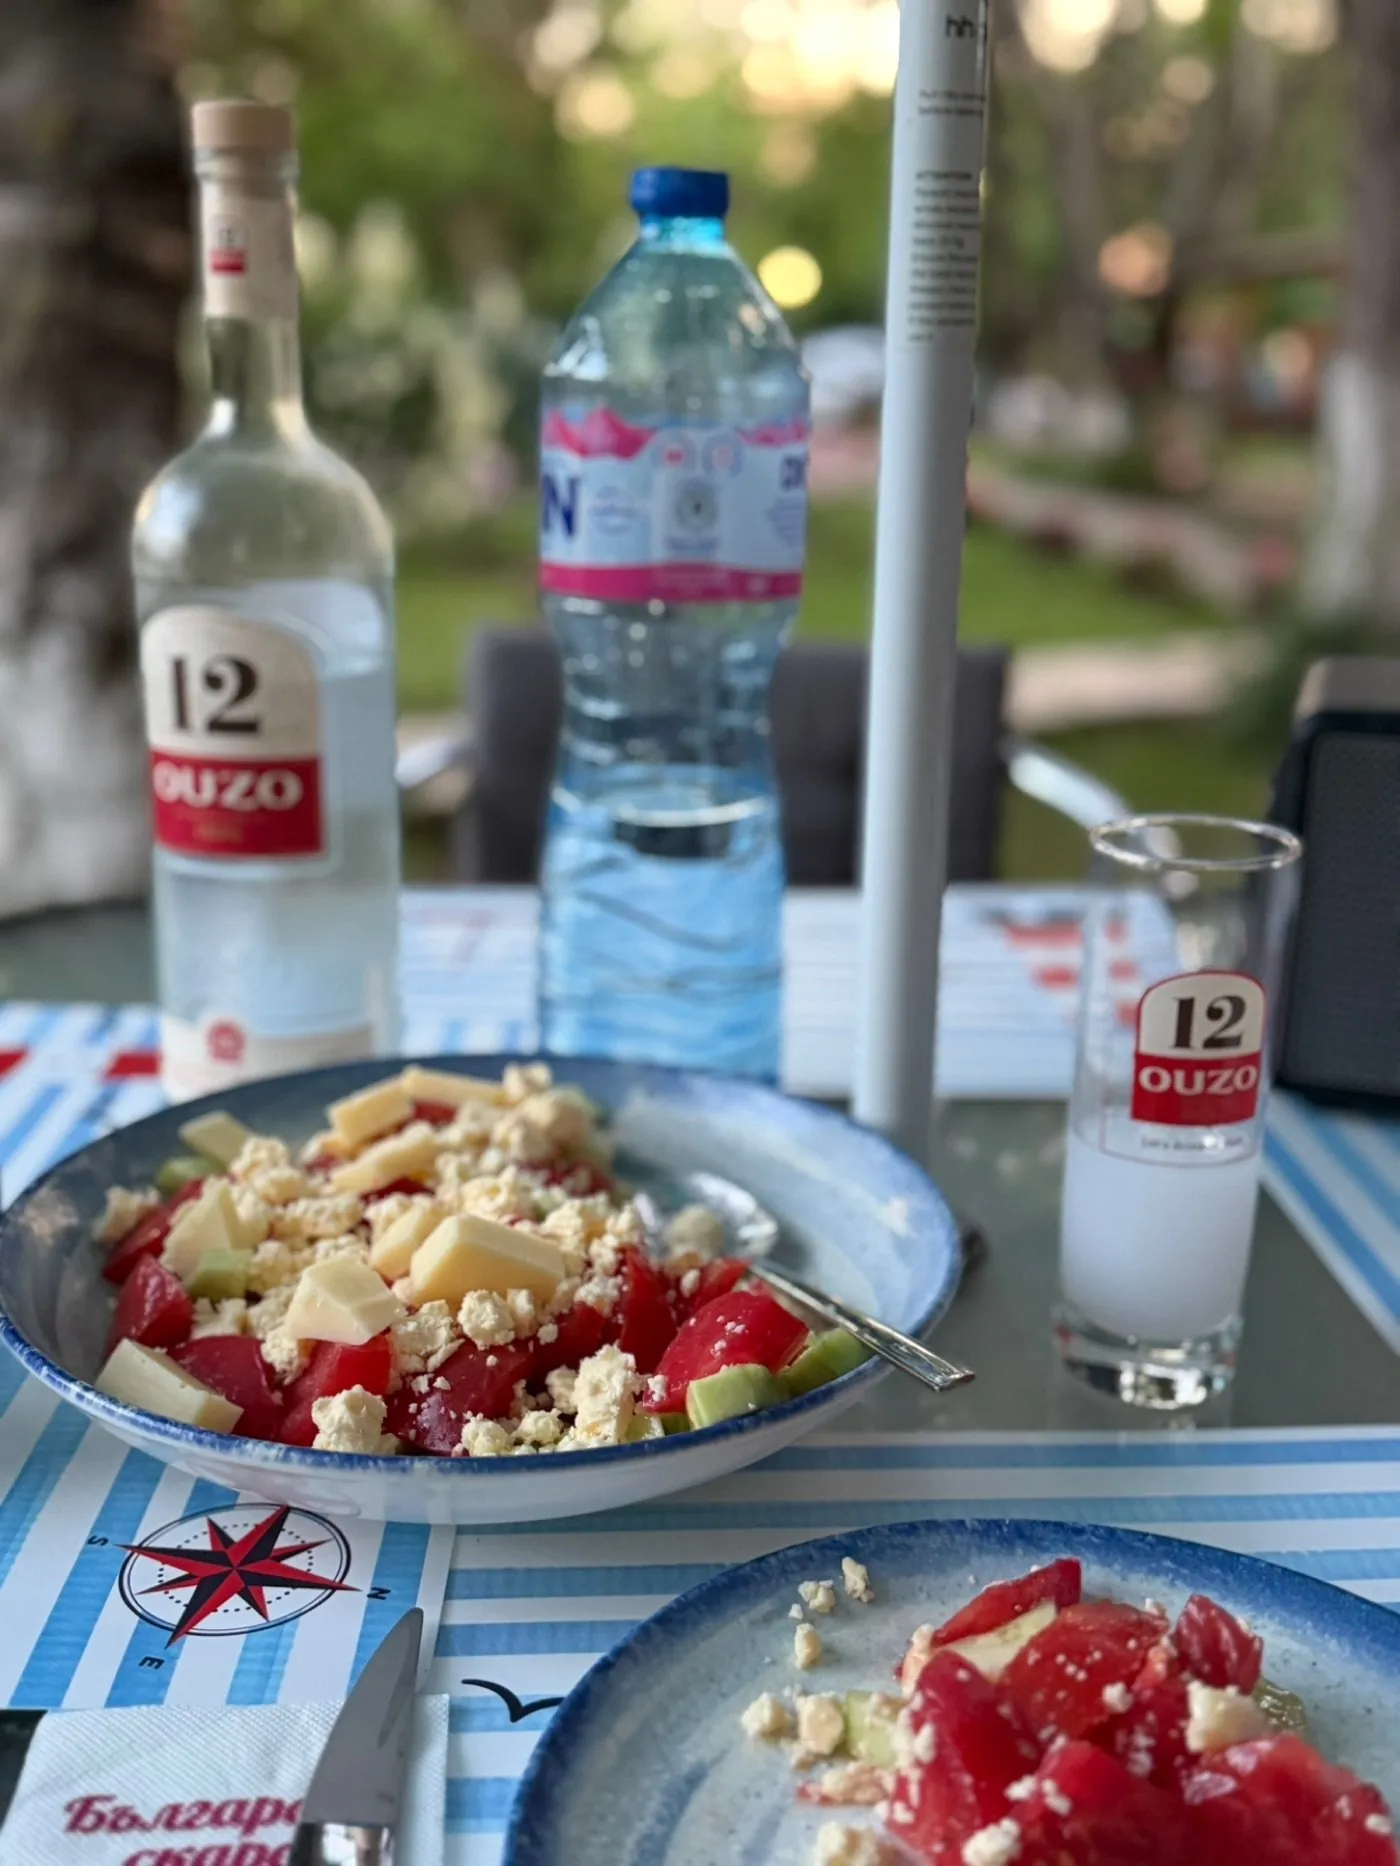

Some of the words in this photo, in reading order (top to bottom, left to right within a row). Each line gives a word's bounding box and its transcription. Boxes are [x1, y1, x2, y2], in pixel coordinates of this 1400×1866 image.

[172, 654, 261, 733] 12
[152, 760, 303, 811] OUZO
[1171, 995, 1247, 1050] 12
[1138, 1064, 1258, 1096] OUZO
[366, 1586, 392, 1601] N
[138, 1655, 165, 1670] E
